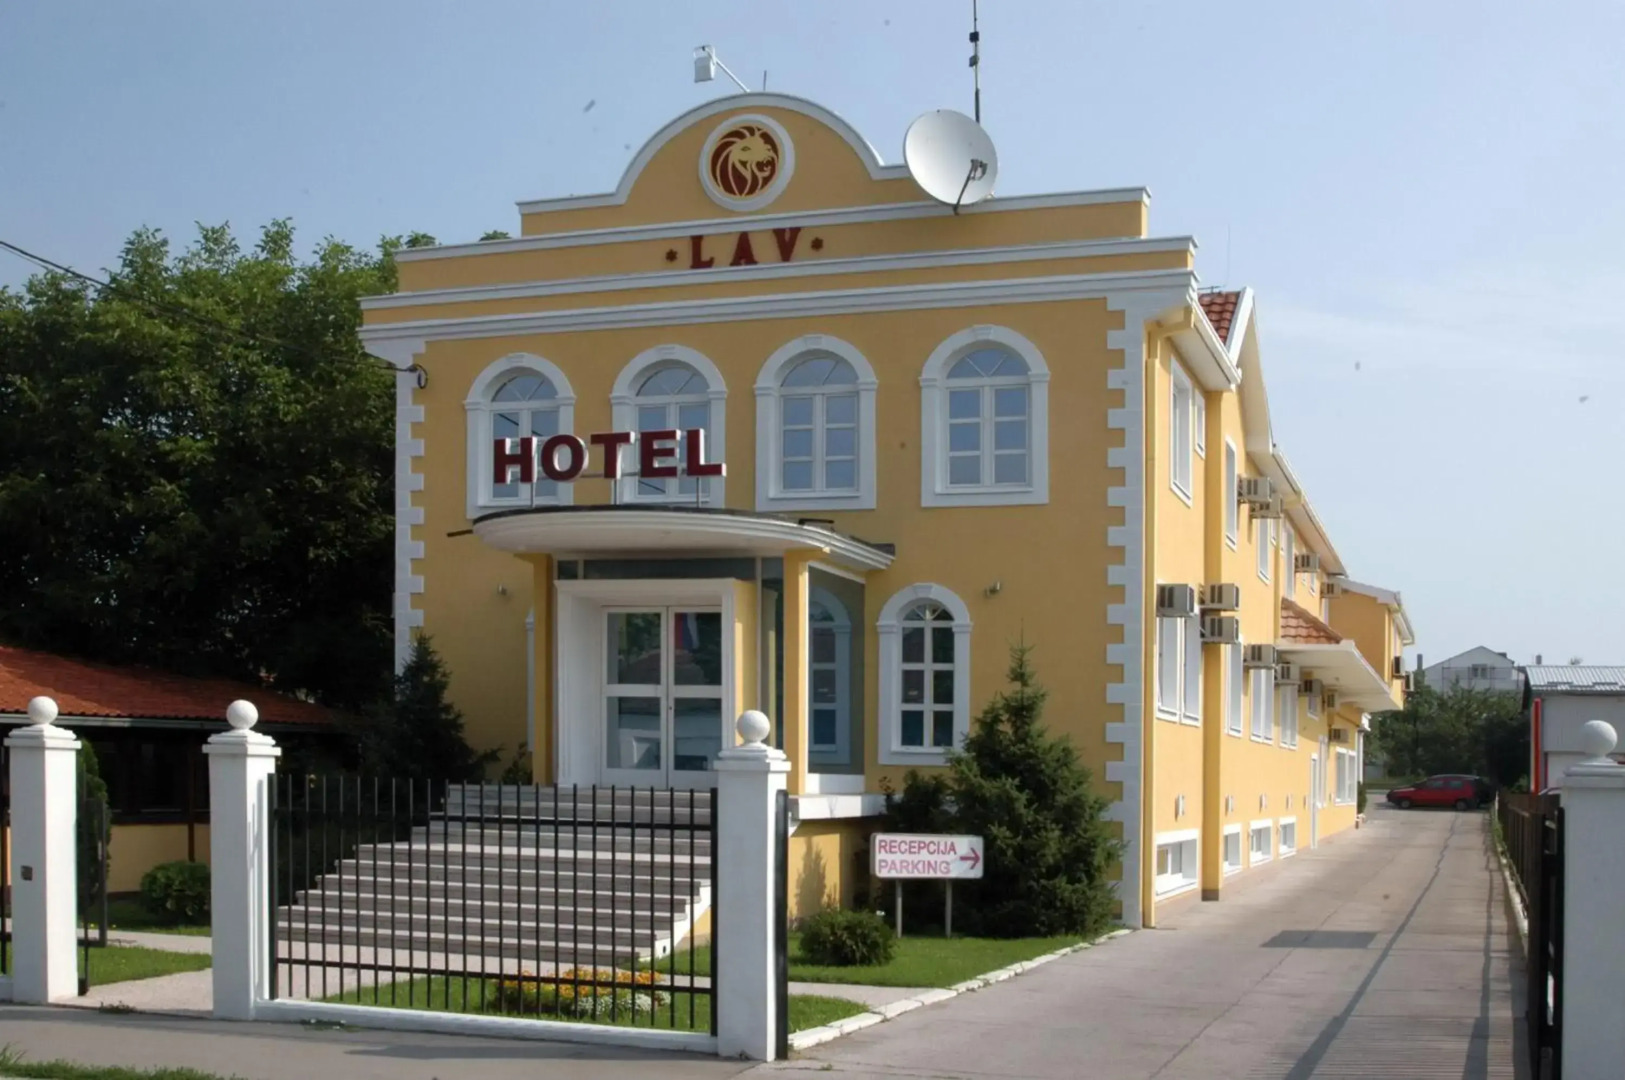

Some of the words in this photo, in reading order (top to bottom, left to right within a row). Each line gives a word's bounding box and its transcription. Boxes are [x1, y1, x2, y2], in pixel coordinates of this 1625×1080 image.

[690, 227, 802, 269] LAV
[493, 428, 726, 484] HOTEL
[878, 840, 957, 855] RECEPCIJA
[878, 859, 951, 875] PARKING
